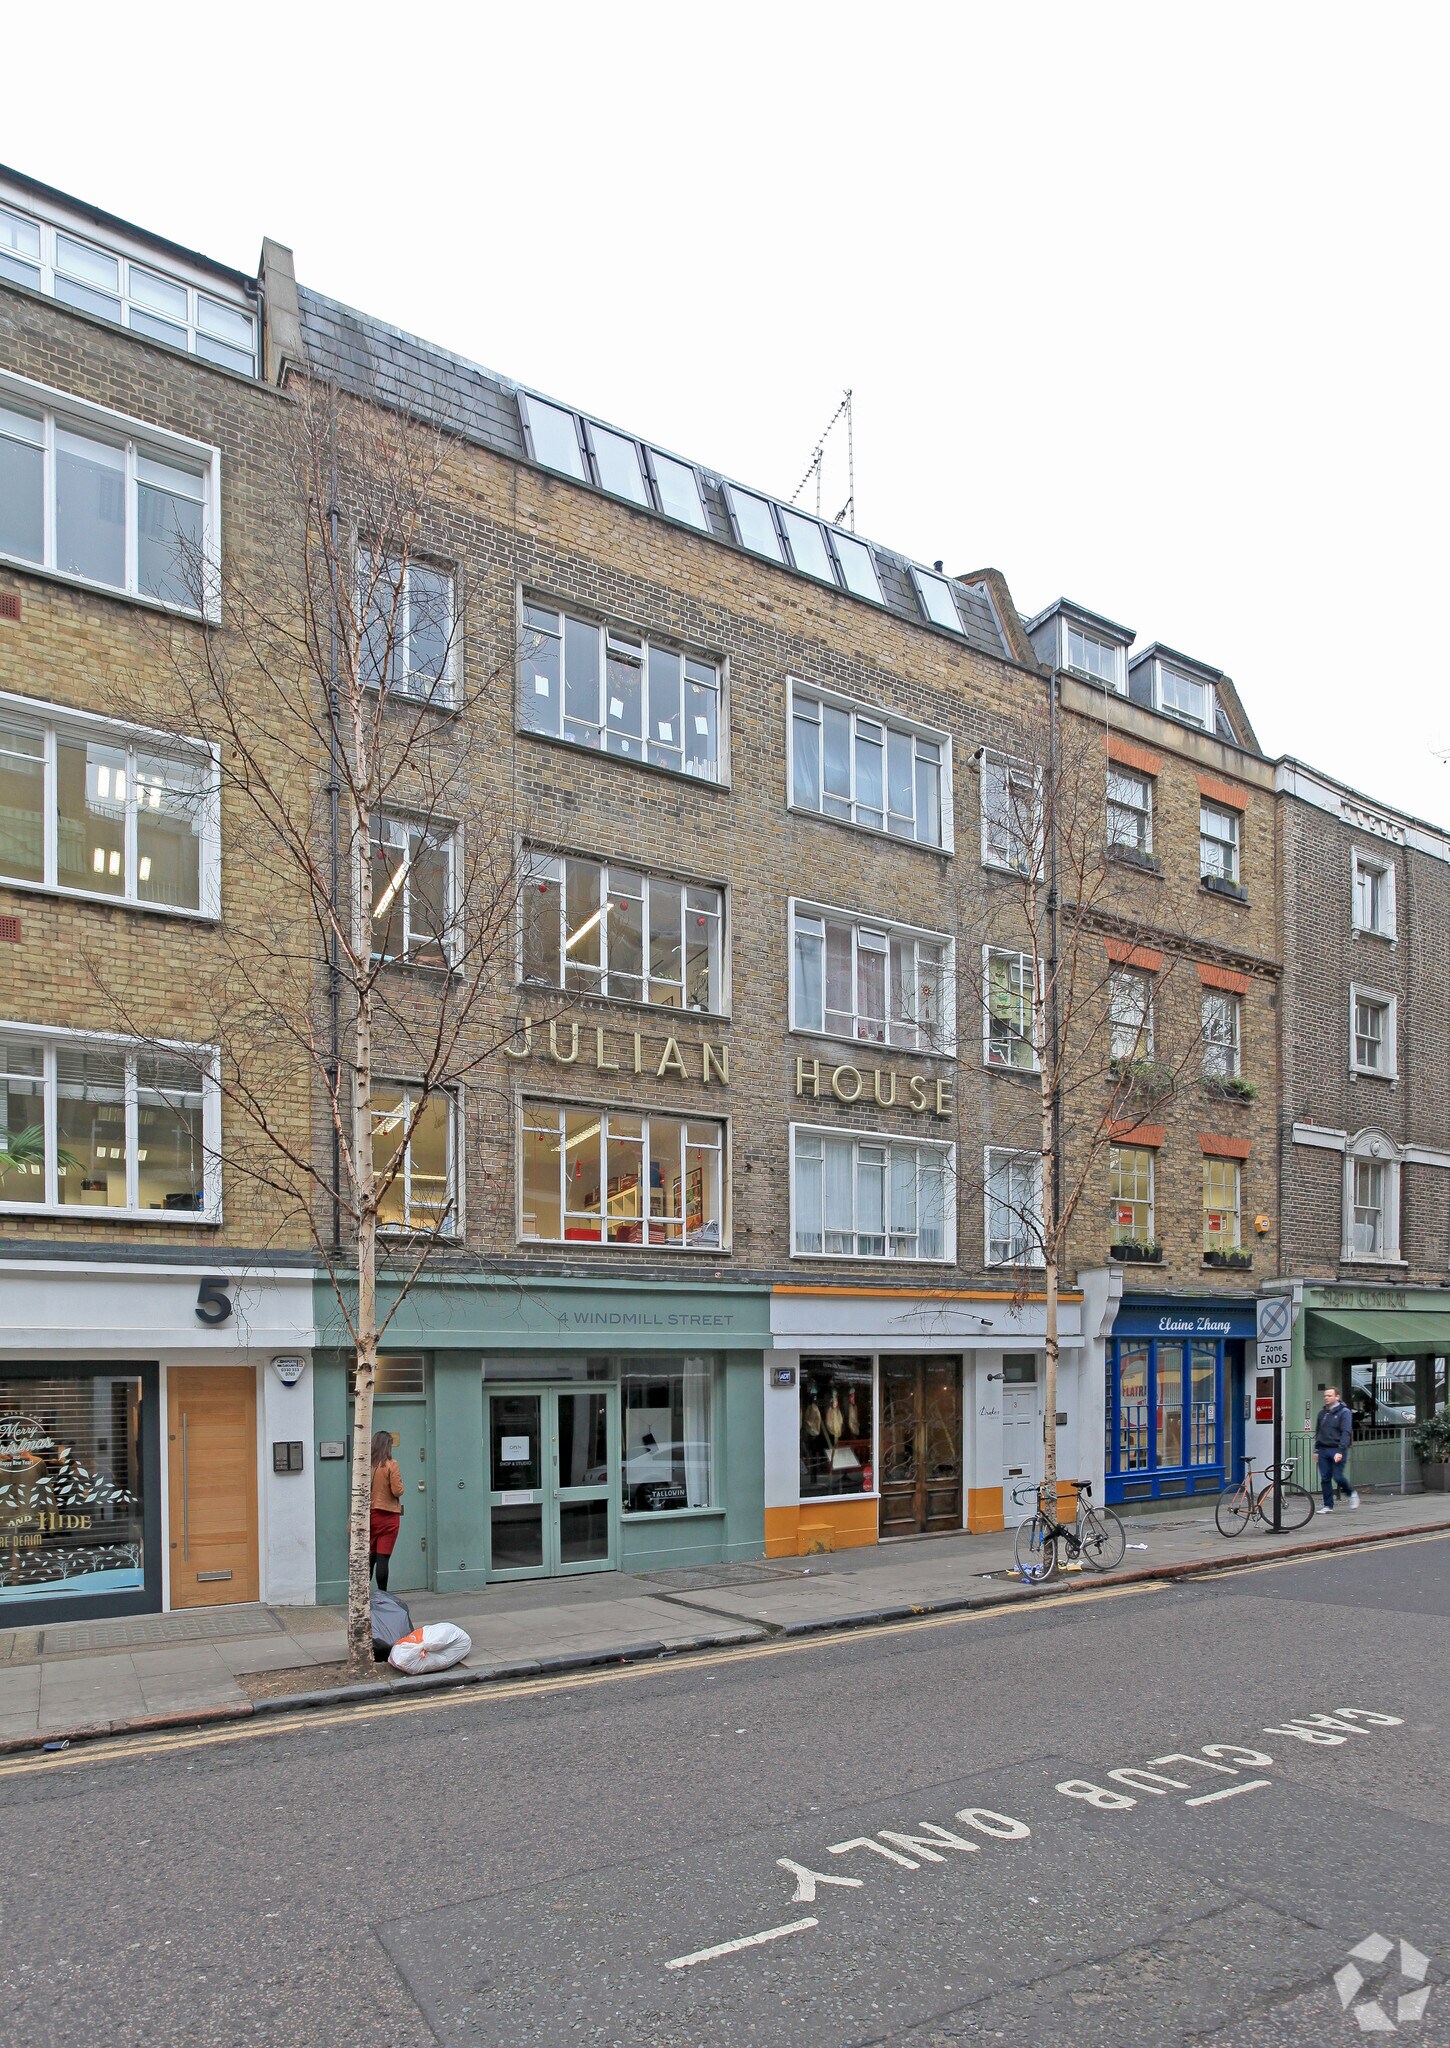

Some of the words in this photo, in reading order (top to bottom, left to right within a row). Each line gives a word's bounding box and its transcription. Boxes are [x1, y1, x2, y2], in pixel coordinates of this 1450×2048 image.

[504, 1017, 729, 1085] JULIAN
[796, 1057, 953, 1115] HOUSE
[195, 1278, 231, 1324] 5
[559, 1312, 568, 1323] 4
[574, 1312, 663, 1325] WINDMILL
[668, 1314, 733, 1325] STREET
[1159, 1317, 1194, 1331] Elaine
[1197, 1317, 1231, 1334] Zhang
[1260, 1353, 1288, 1364] ENDS
[1013, 1401, 1018, 1409] 3
[0, 1421, 39, 1442] Merry
[7, 1515, 33, 1527] AND
[37, 1511, 92, 1530] HIDE
[13, 1534, 42, 1547] DENIM
[1262, 1708, 1404, 1745] CAR
[1055, 1744, 1273, 1810] CLUB
[776, 1808, 1030, 1901] ONLY
